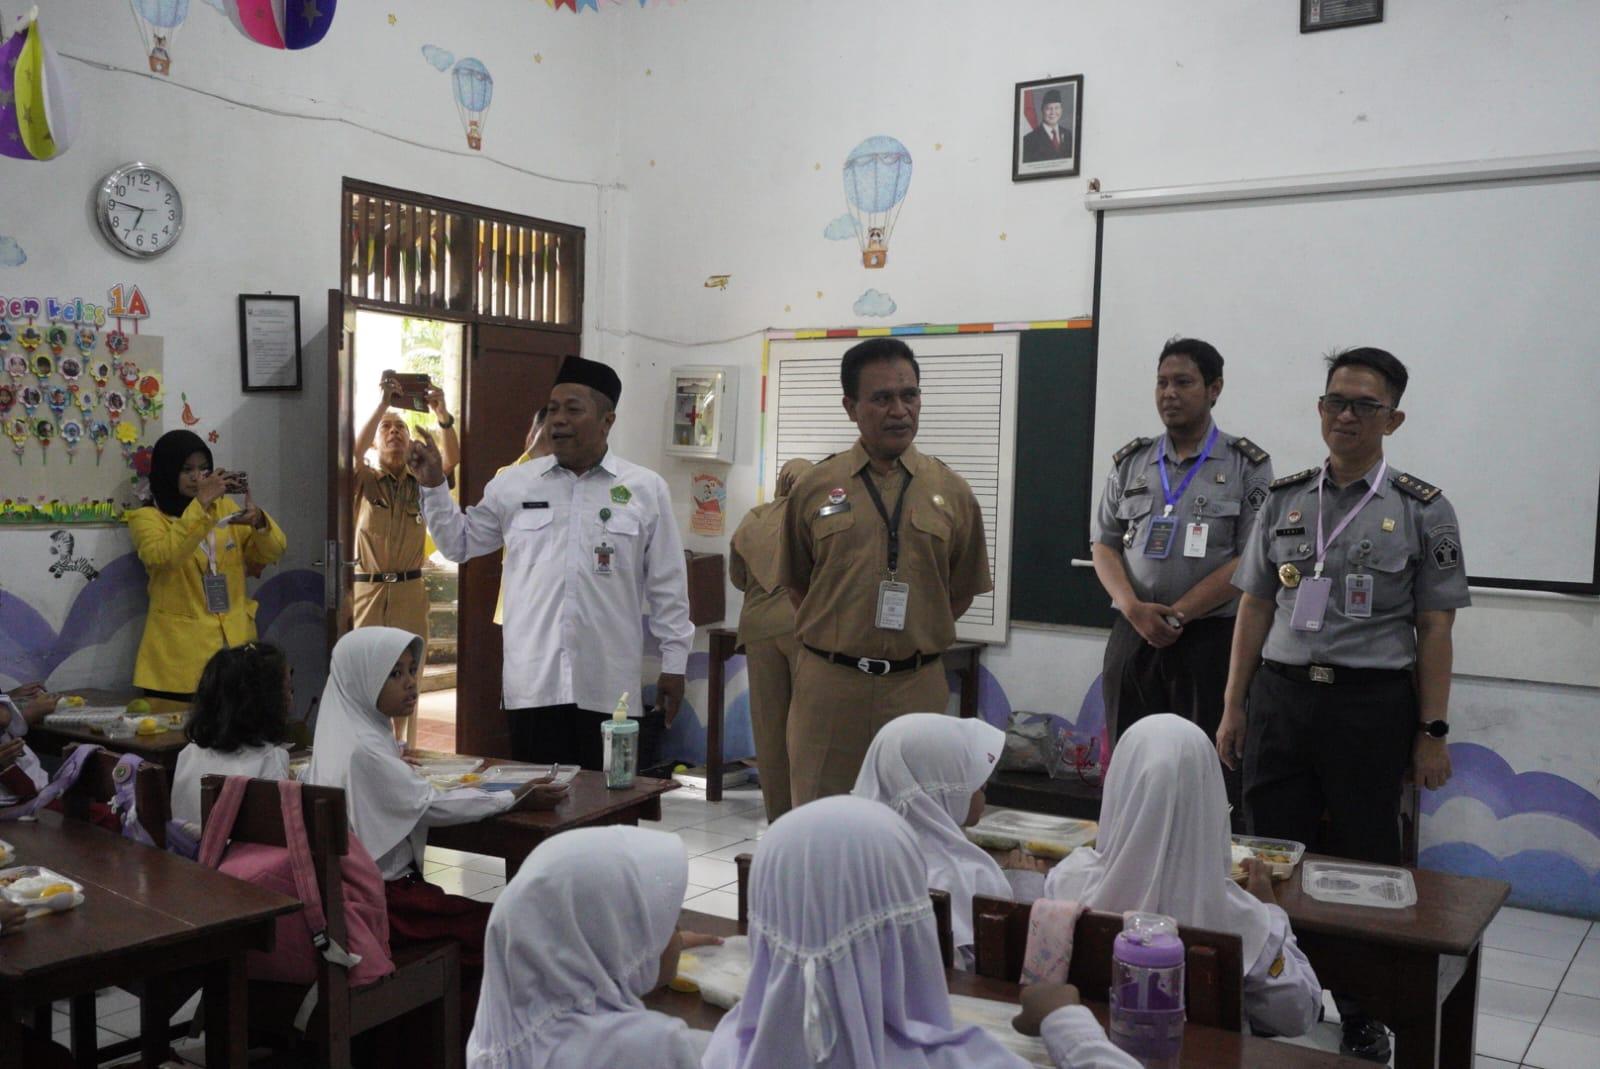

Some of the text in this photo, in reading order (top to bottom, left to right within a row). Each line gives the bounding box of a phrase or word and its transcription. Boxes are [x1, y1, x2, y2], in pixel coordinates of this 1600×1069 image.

[126, 174, 136, 187] 11
[140, 173, 151, 186] 12
[114, 184, 126, 197] 10
[155, 180, 161, 192] 1
[108, 199, 116, 211] 9
[164, 193, 172, 205] 2
[168, 209, 176, 221] 3
[112, 216, 120, 228] 8
[123, 228, 131, 240] 7
[162, 225, 169, 235] 4
[136, 234, 143, 246] 6
[151, 233, 158, 245] 5
[48, 298, 104, 325] kelas
[109, 284, 148, 317] 1A
